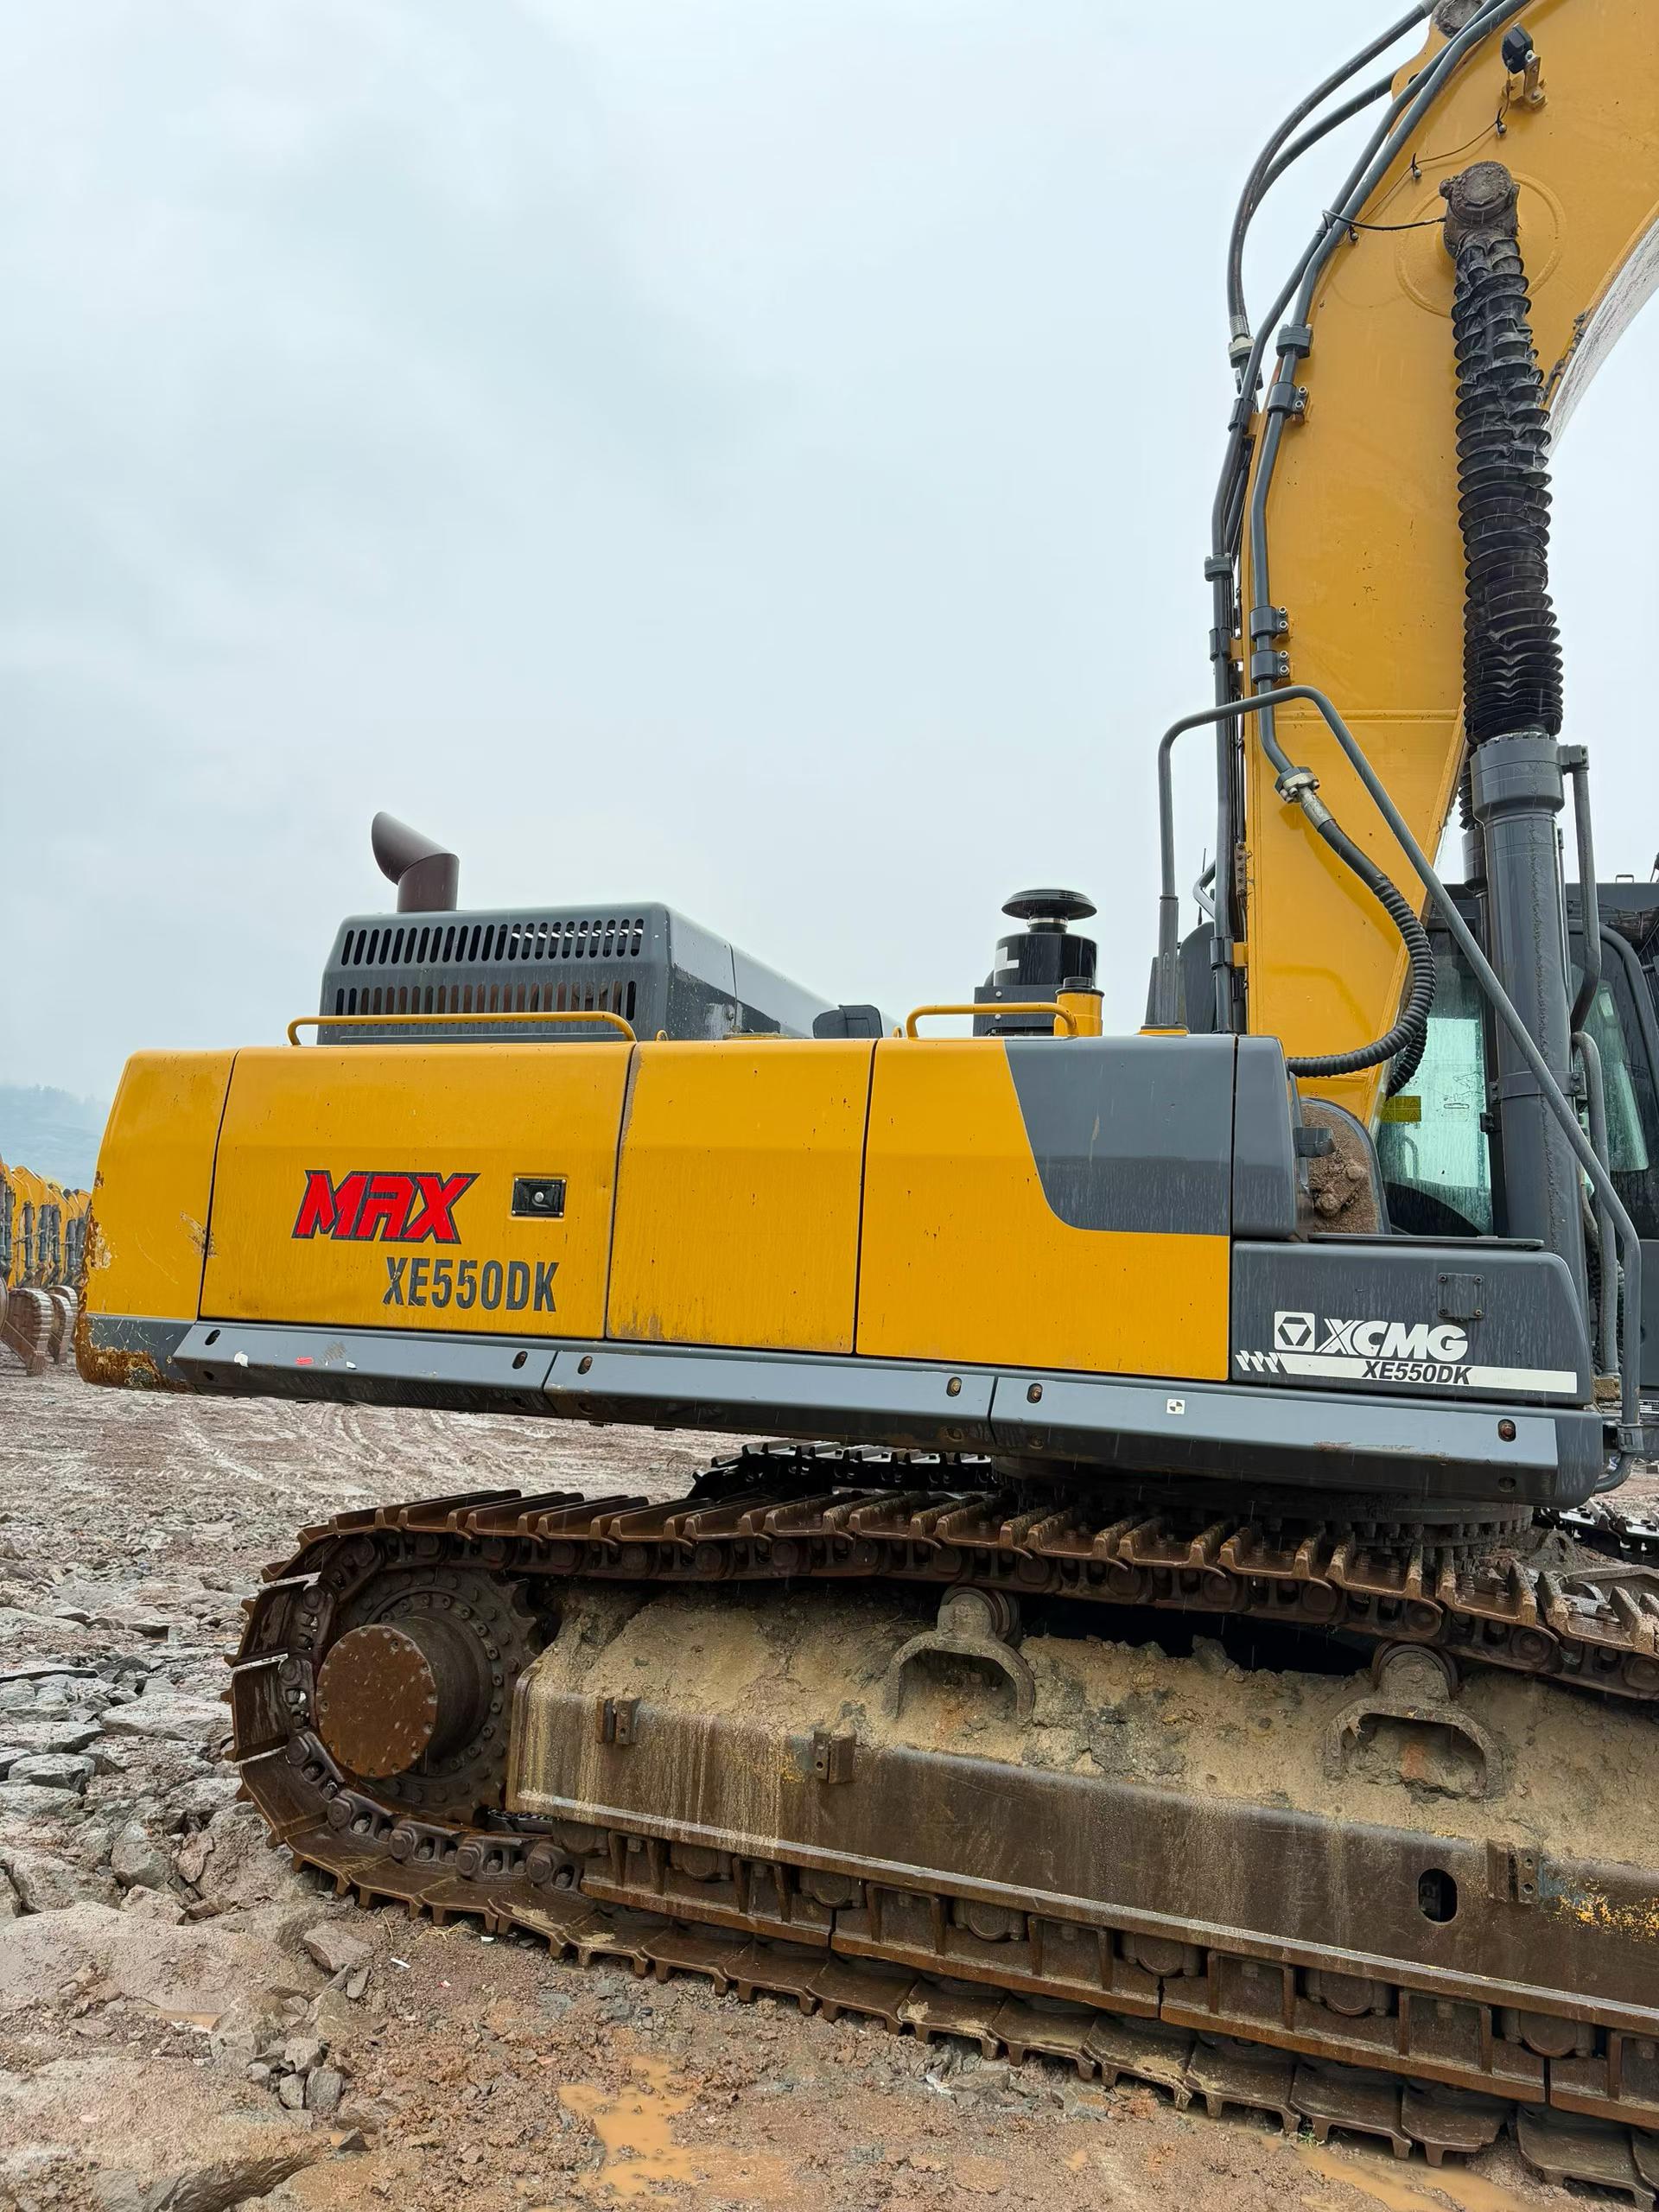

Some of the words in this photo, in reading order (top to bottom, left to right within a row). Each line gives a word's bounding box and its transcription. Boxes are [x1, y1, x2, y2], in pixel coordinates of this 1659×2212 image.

[291, 1169, 481, 1244] MAX
[383, 1256, 560, 1313] XE550DK
[1314, 1318, 1469, 1362] XCMG
[1361, 1360, 1472, 1385] XE550DK
